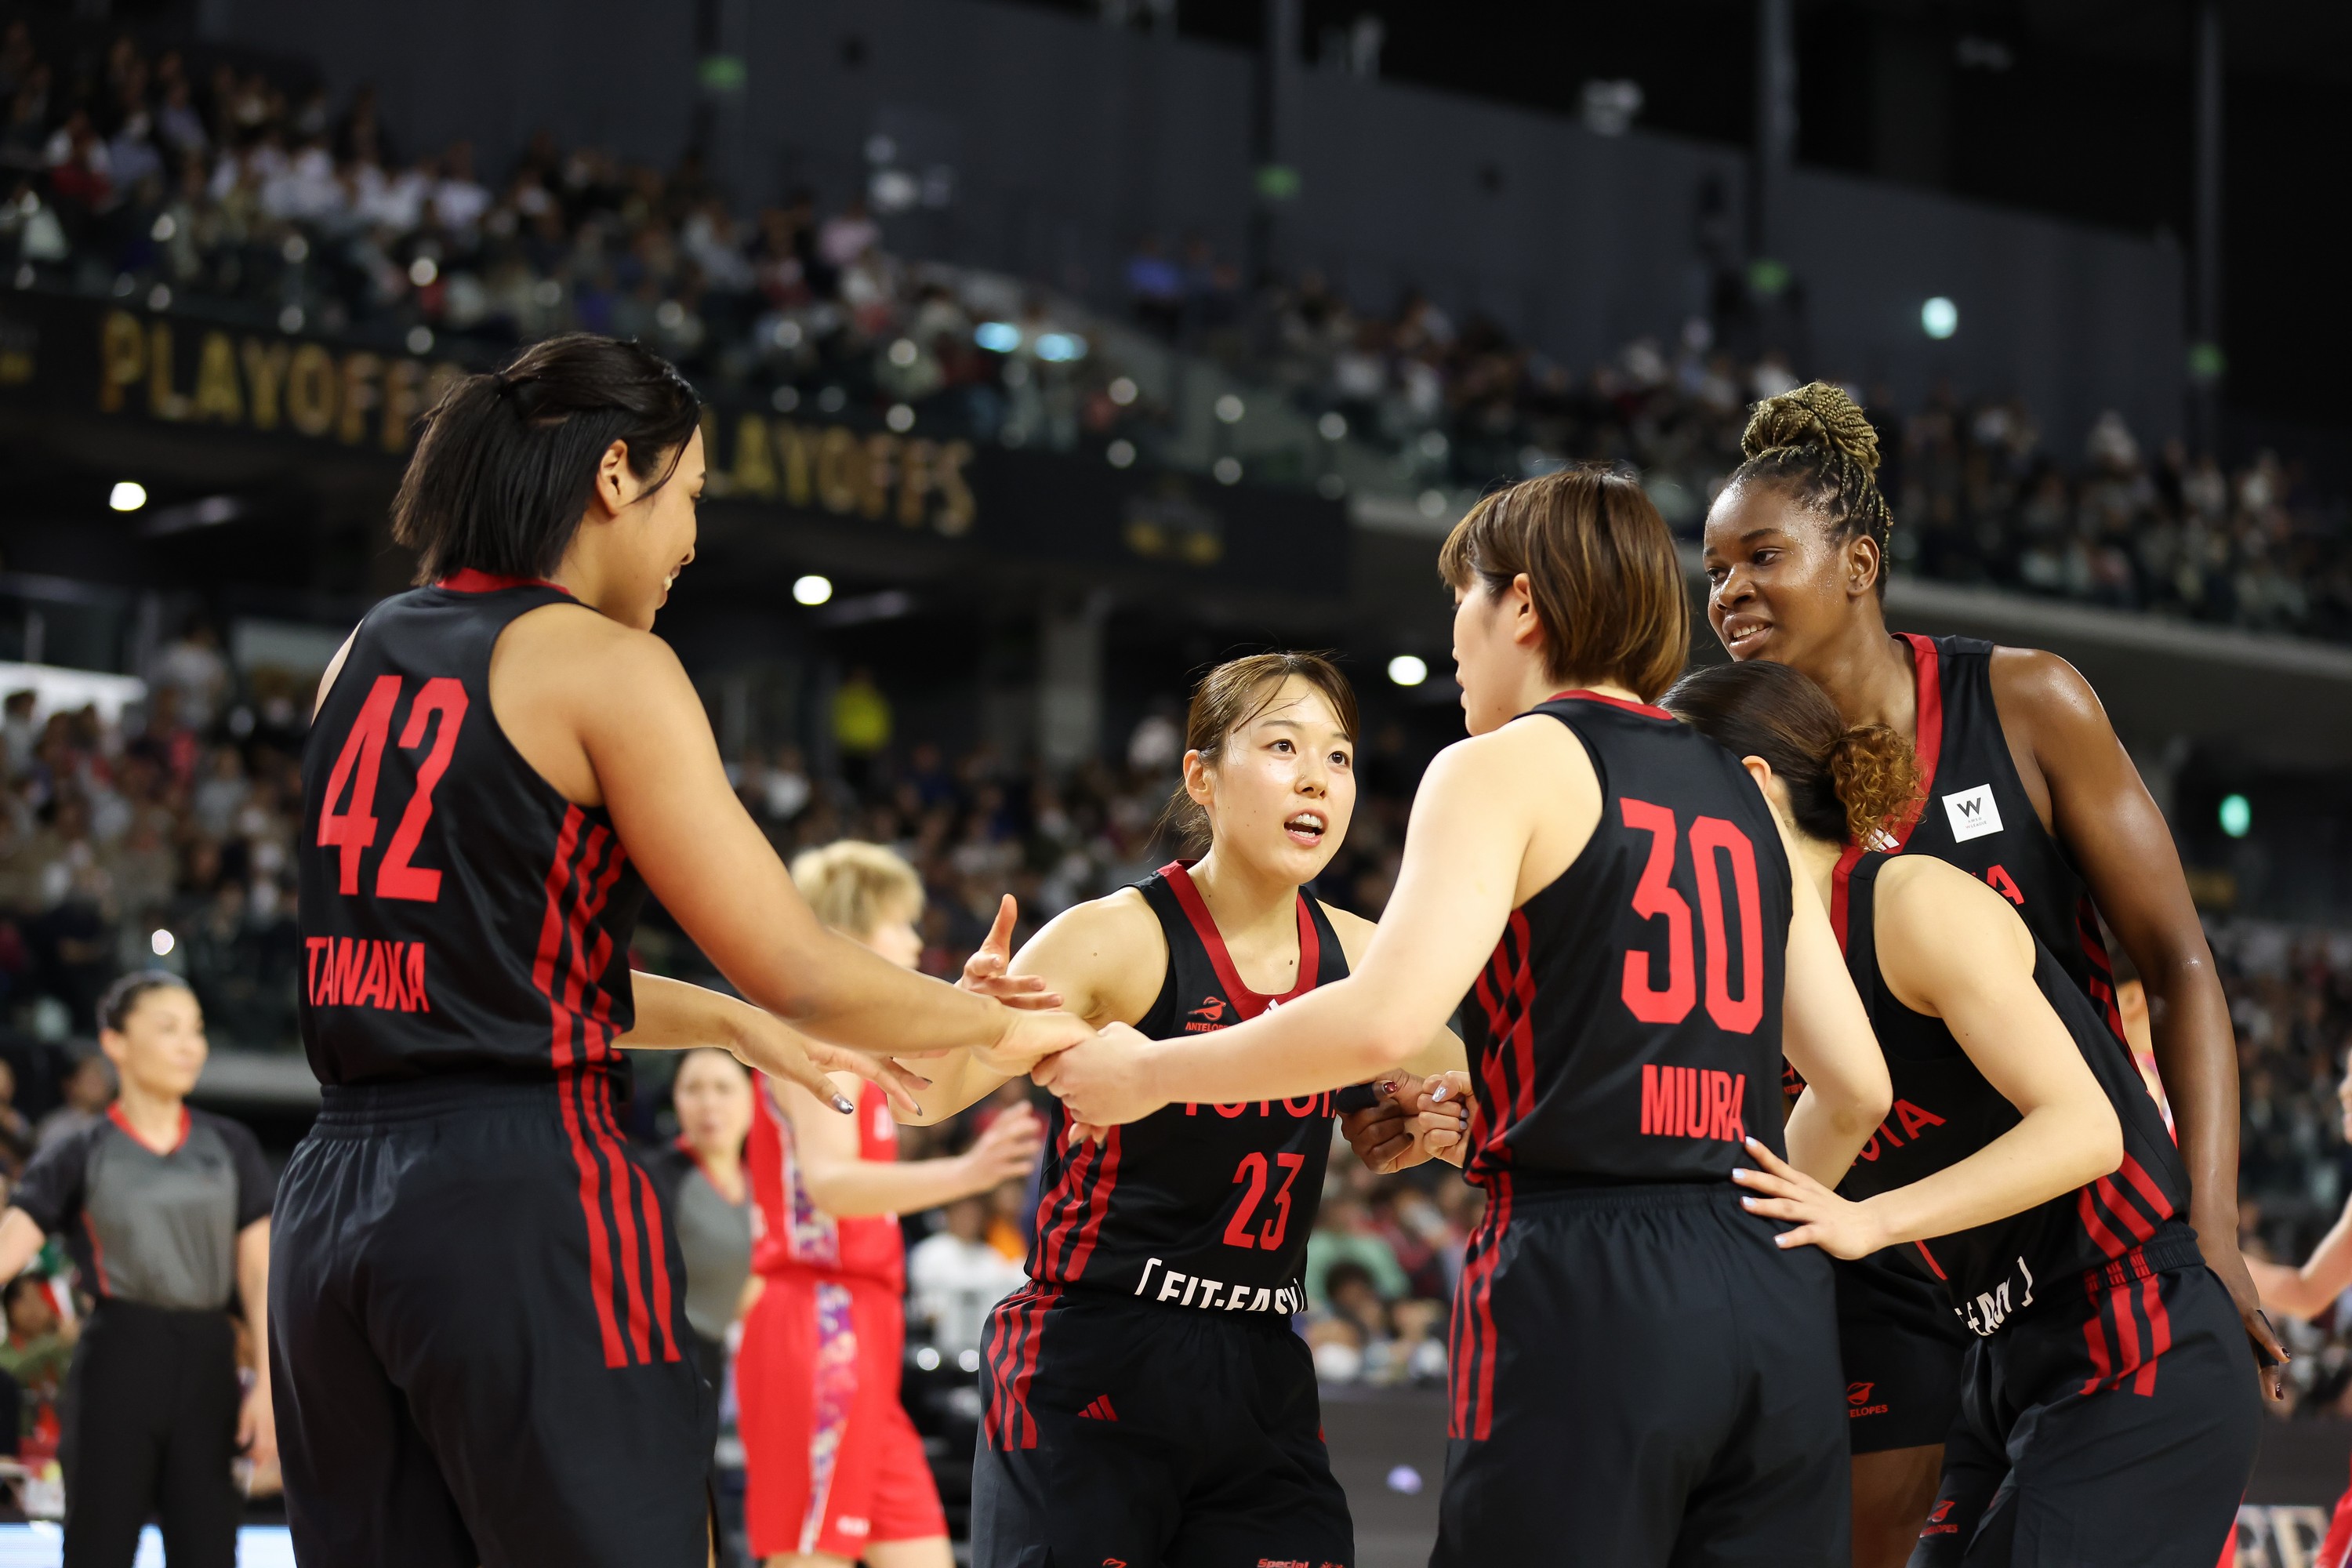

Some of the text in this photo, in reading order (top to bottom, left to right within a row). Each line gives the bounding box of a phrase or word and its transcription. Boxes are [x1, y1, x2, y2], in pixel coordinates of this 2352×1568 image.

[698, 401, 977, 538] LAYOFFS
[317, 675, 470, 902] 42
[1956, 797, 1981, 818] W
[1619, 797, 1763, 1035] 30
[306, 935, 430, 1013] TANAKA
[1640, 1064, 1746, 1143] MIURA
[1223, 1151, 1305, 1250] 23
